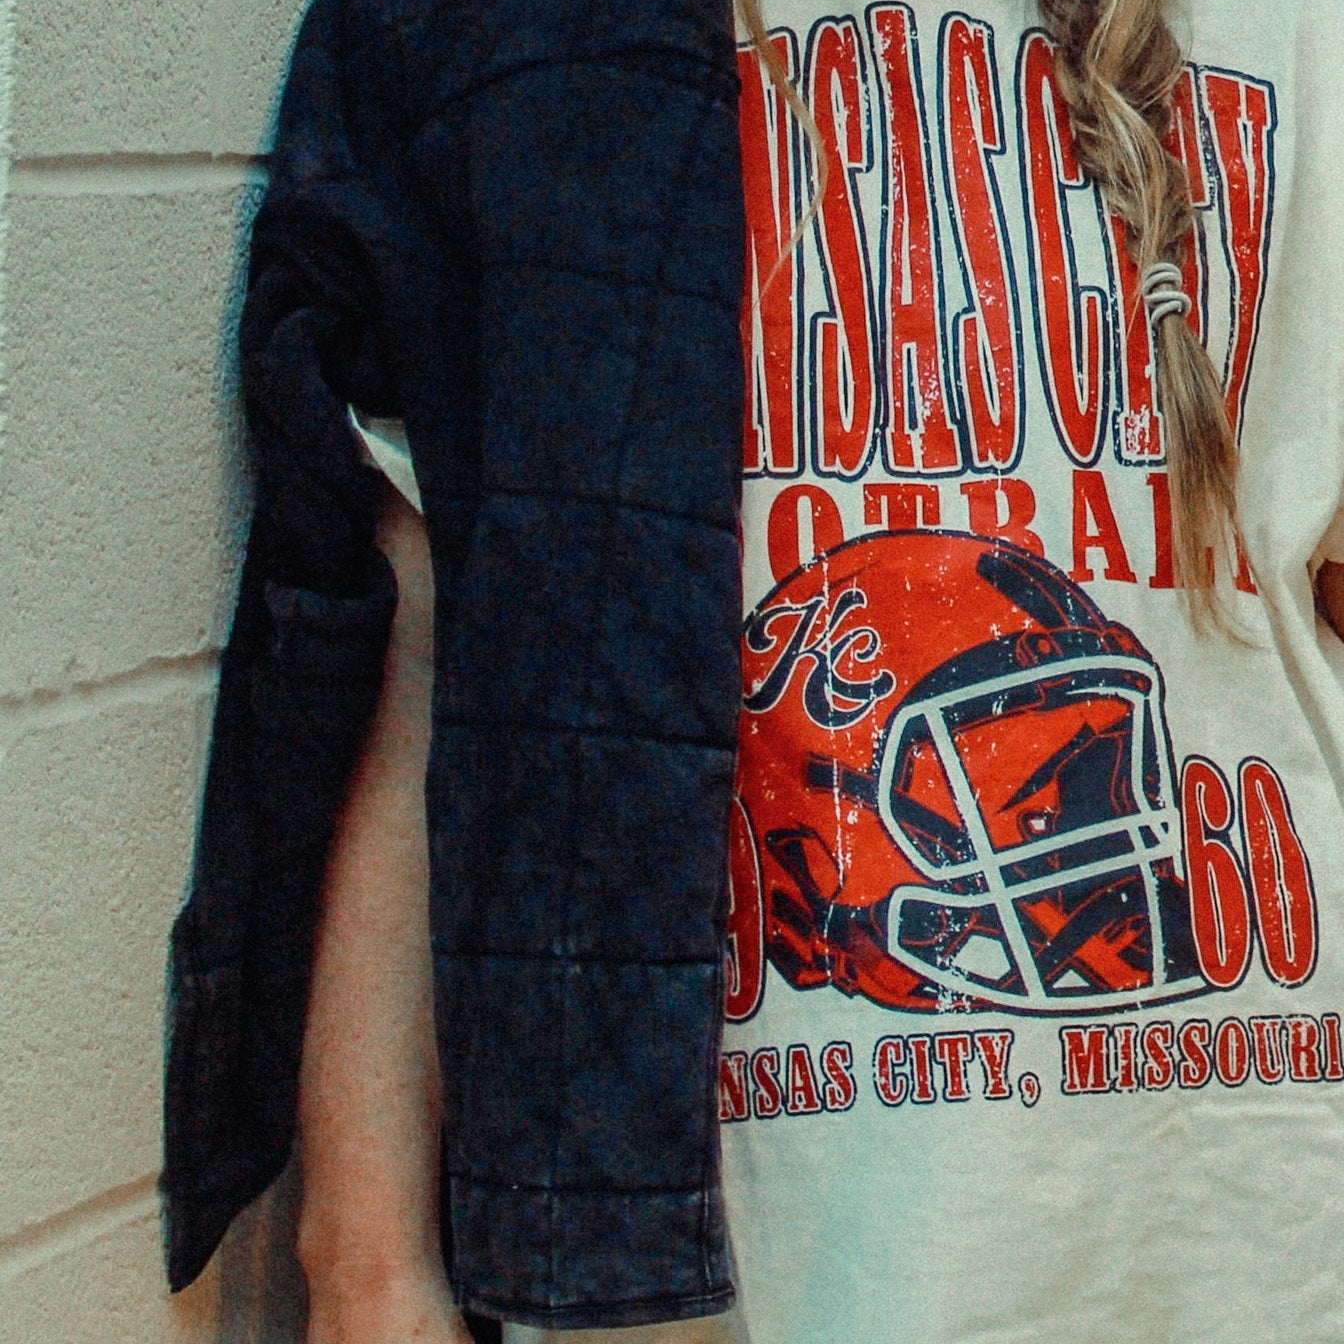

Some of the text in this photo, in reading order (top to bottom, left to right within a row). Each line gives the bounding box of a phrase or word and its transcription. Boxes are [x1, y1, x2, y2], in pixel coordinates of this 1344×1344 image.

[737, 0, 1022, 478] NSAS
[1180, 755, 1320, 989] 60
[717, 1040, 857, 1124] NSAS
[873, 1027, 1041, 1108] CITY,
